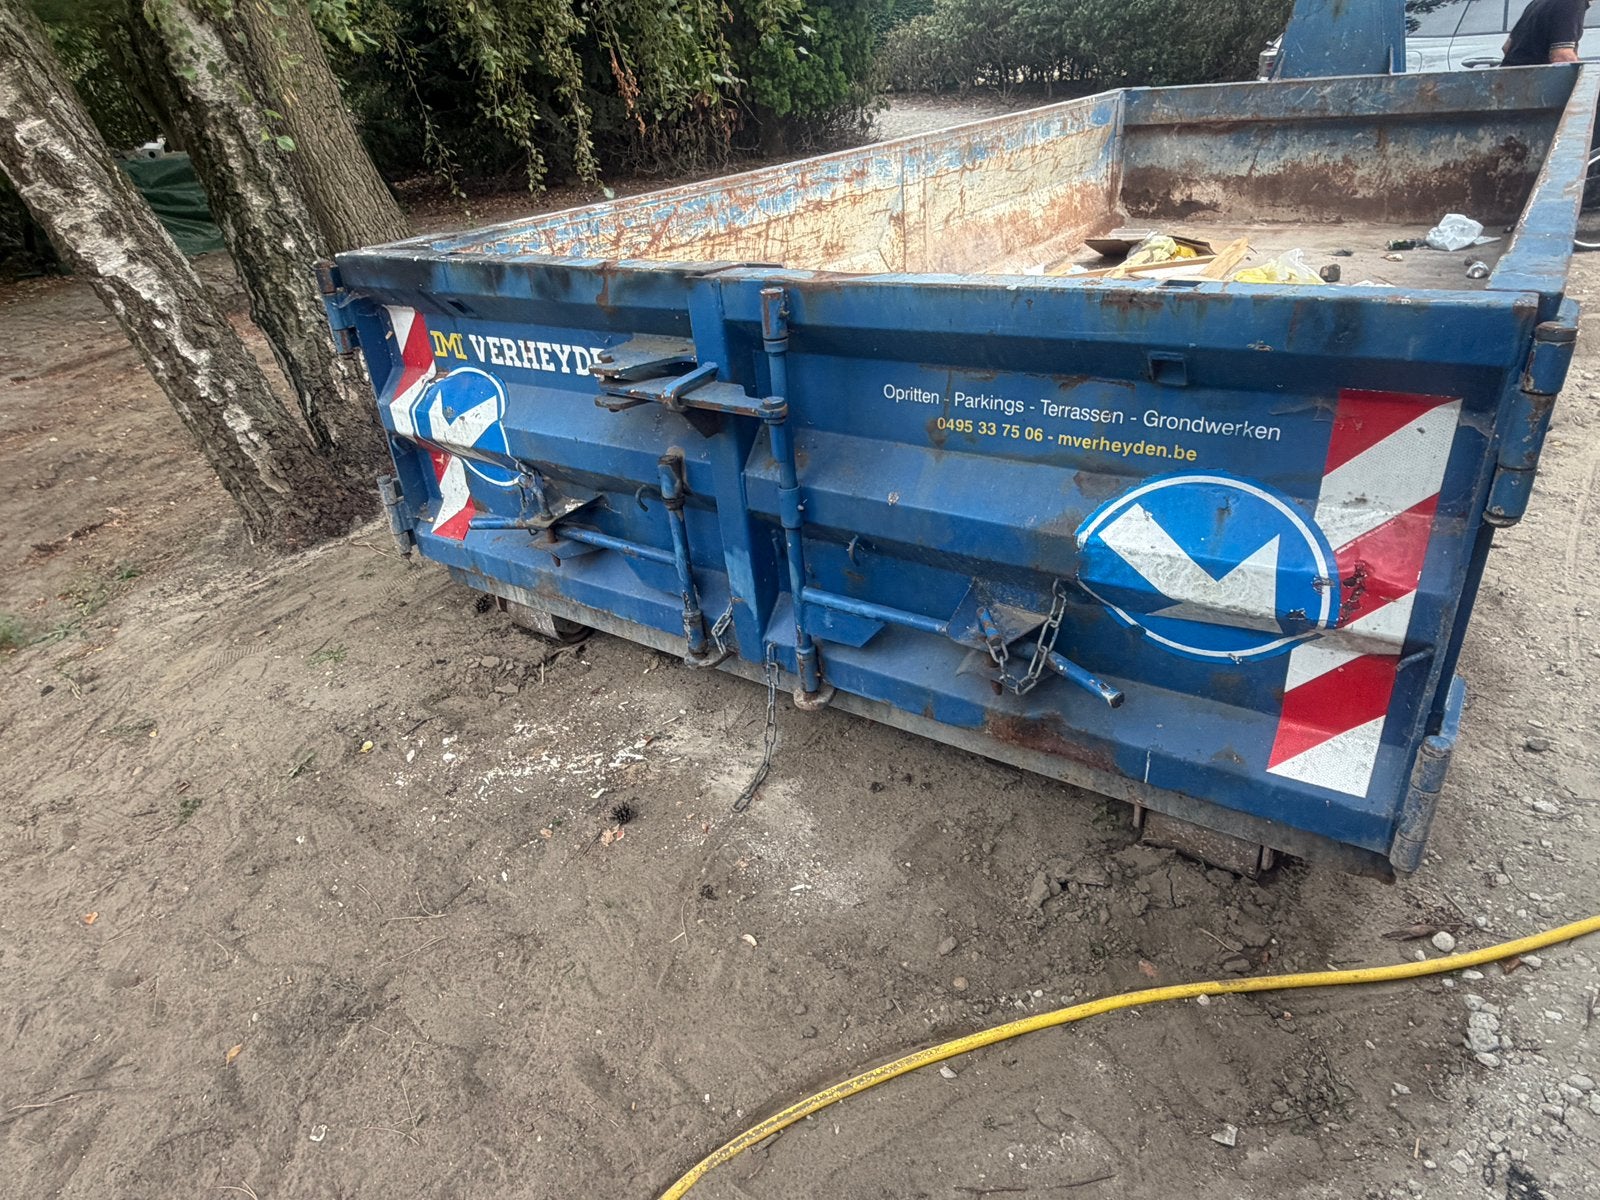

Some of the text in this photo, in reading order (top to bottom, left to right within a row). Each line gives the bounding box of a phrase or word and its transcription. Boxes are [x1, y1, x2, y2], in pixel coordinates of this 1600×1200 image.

[883, 384, 940, 405] Opritten
[954, 392, 1025, 416] Parkings
[1041, 399, 1124, 425] Terrassen
[1143, 409, 1282, 441] Grondwerken
[937, 417, 974, 433] 0495
[977, 421, 997, 436] 33
[1002, 424, 1021, 439] 75
[1024, 427, 1044, 442] 06
[1057, 433, 1198, 461] mverheyden.be
